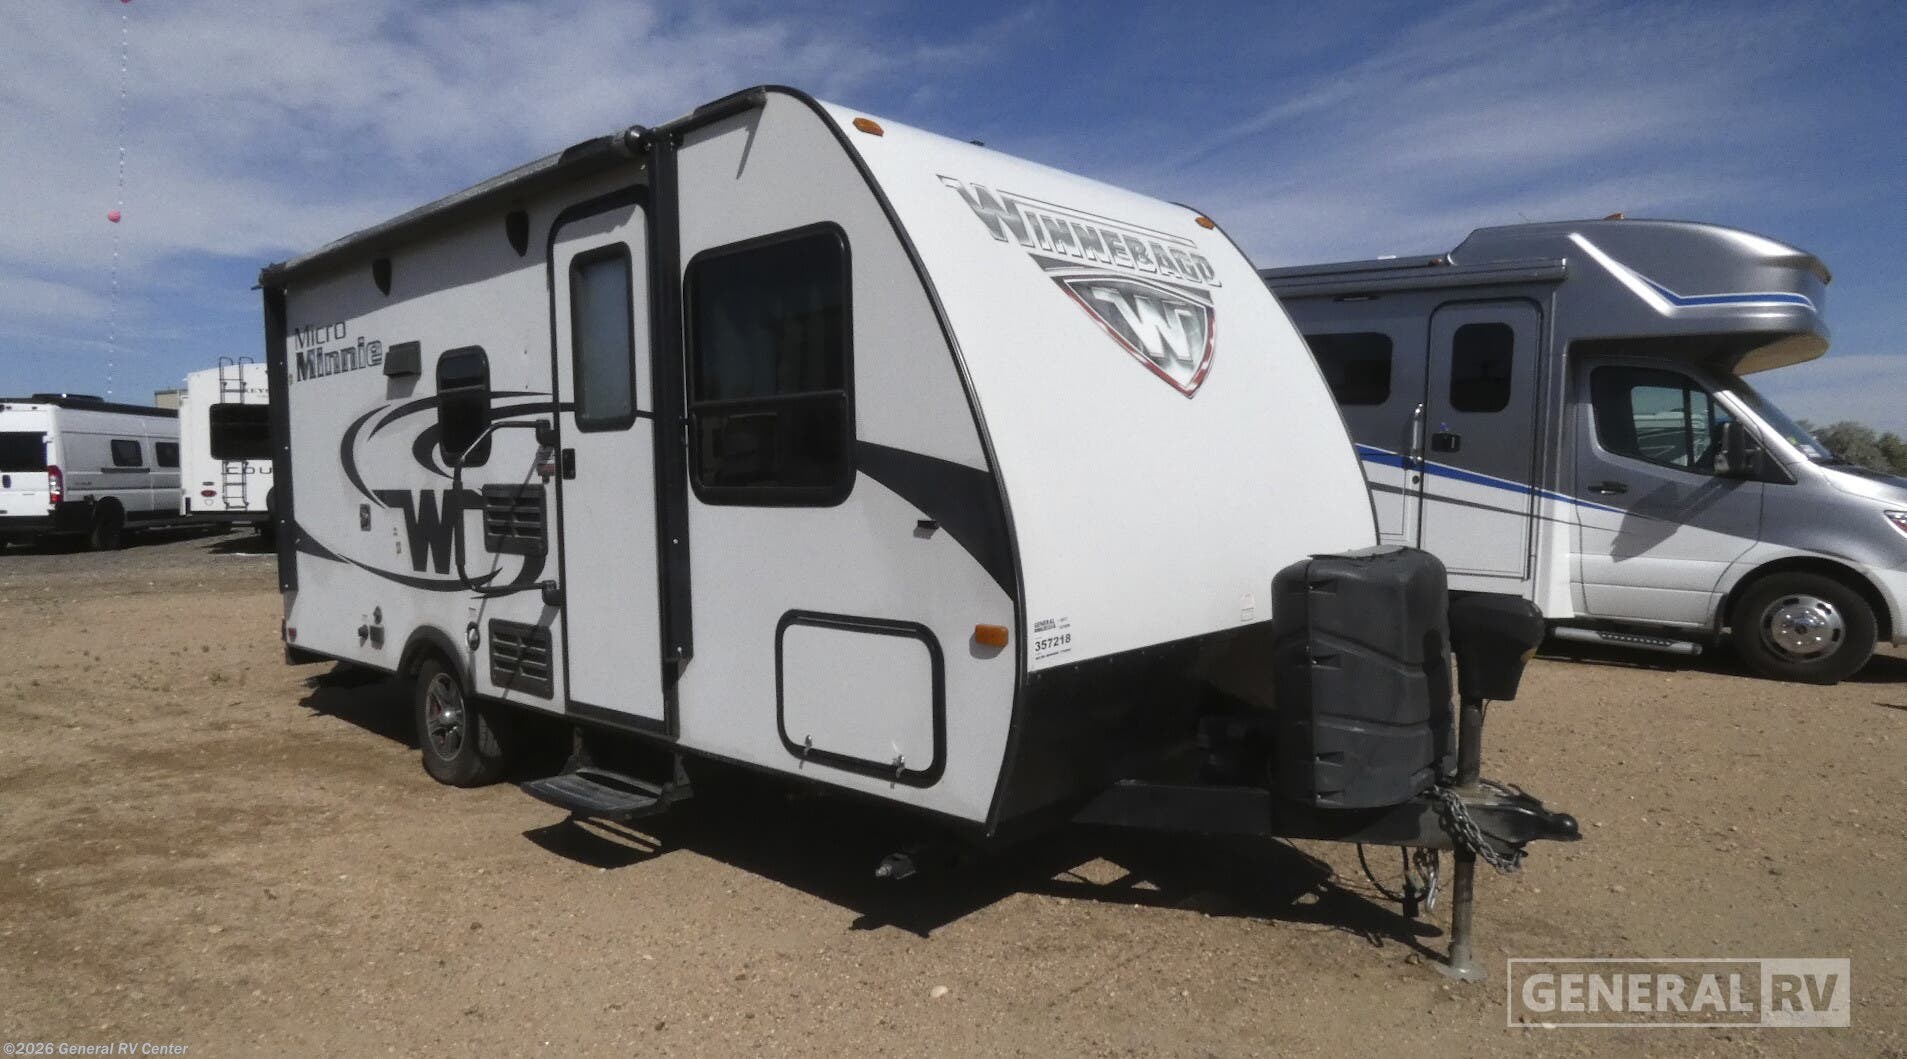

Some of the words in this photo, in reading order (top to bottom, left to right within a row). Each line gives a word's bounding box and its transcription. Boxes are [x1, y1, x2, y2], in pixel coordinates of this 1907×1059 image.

[936, 174, 1222, 287] WINNEBAGO
[1092, 286, 1193, 362] W
[296, 336, 382, 381] Minnie
[1035, 633, 1071, 652] 357218
